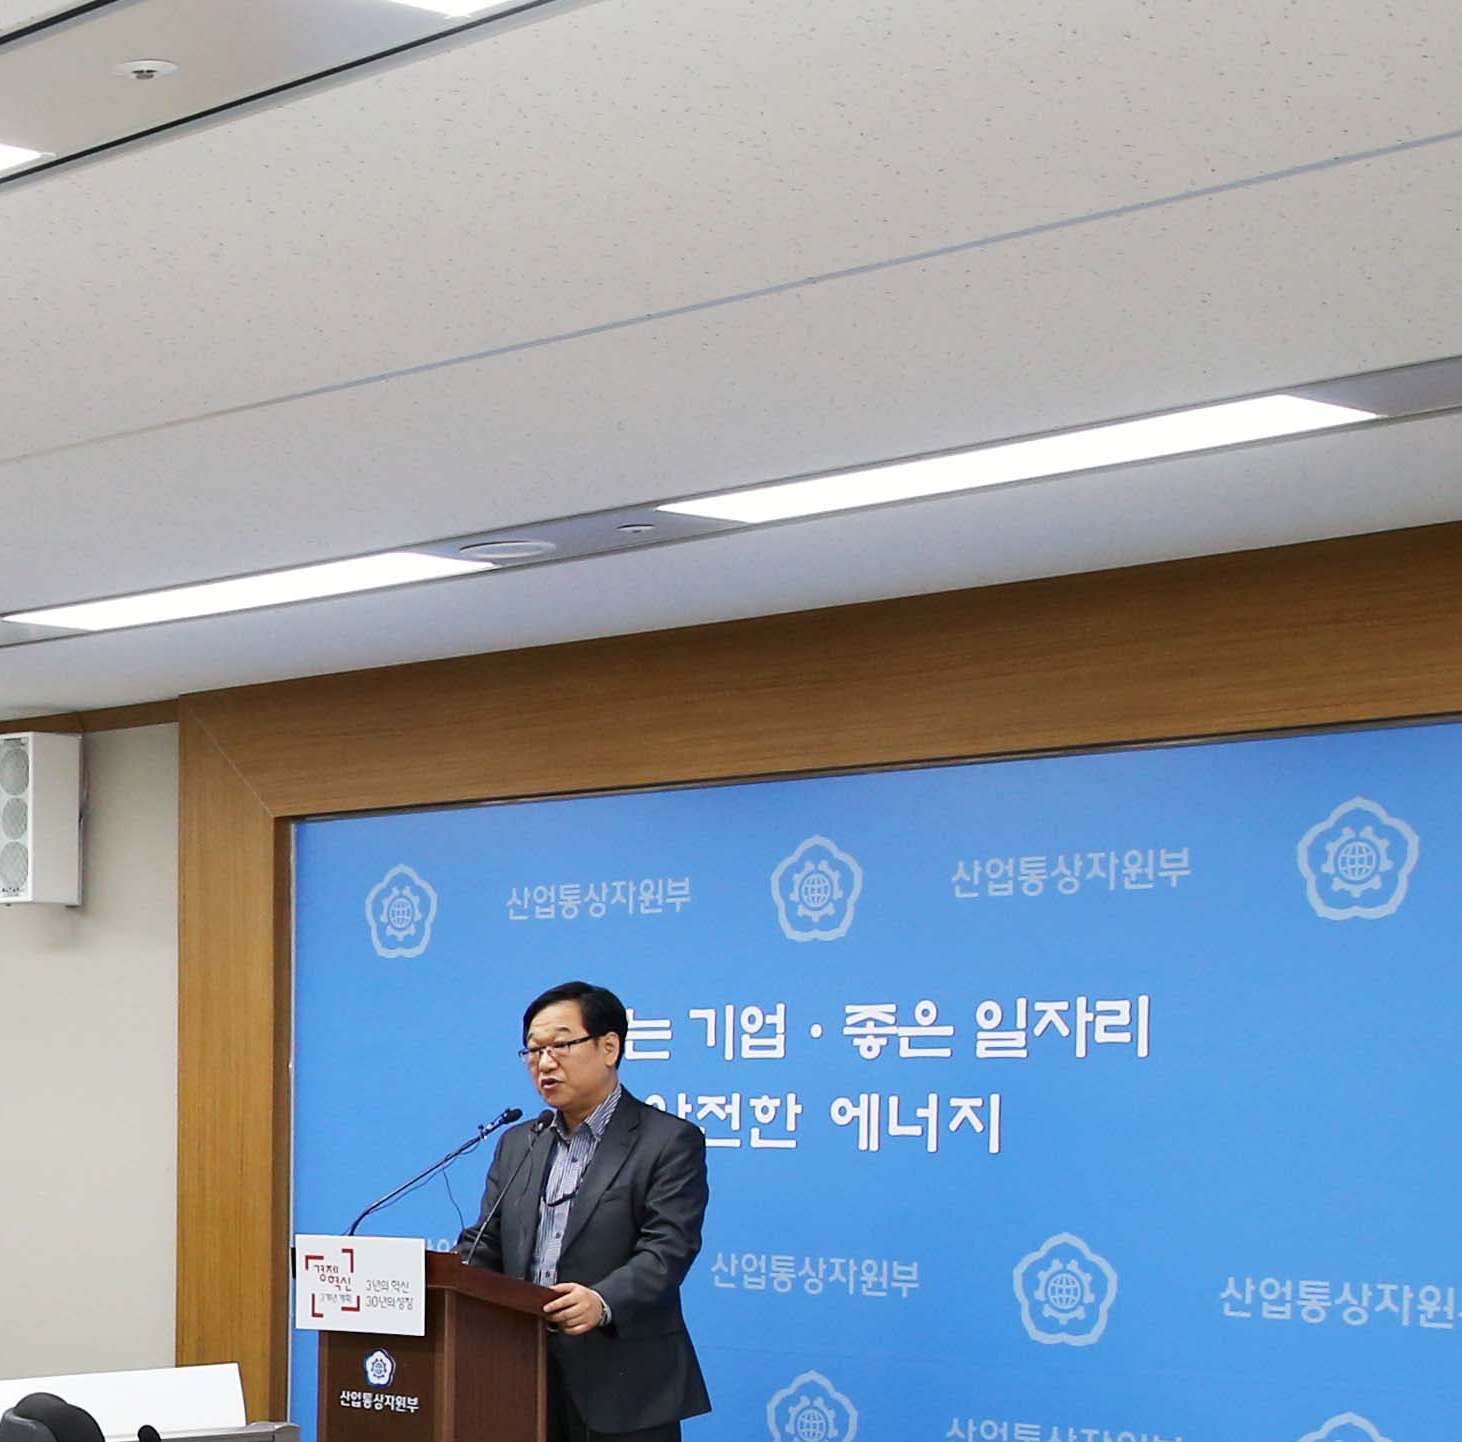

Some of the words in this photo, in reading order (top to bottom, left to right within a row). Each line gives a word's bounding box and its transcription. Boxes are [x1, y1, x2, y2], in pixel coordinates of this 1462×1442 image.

[505, 877, 692, 921] 산업통상자원부
[950, 847, 1191, 900] 산업통상자원부
[689, 1002, 786, 1061] 기업
[843, 1000, 955, 1061] 좋은
[975, 994, 1150, 1060] 일자리
[829, 1092, 1001, 1154] 에너지
[710, 1250, 921, 1299] 산업통상자원부
[1219, 1275, 1462, 1331] 산업통상자원
[339, 1389, 420, 1413] 산업통상자원부
